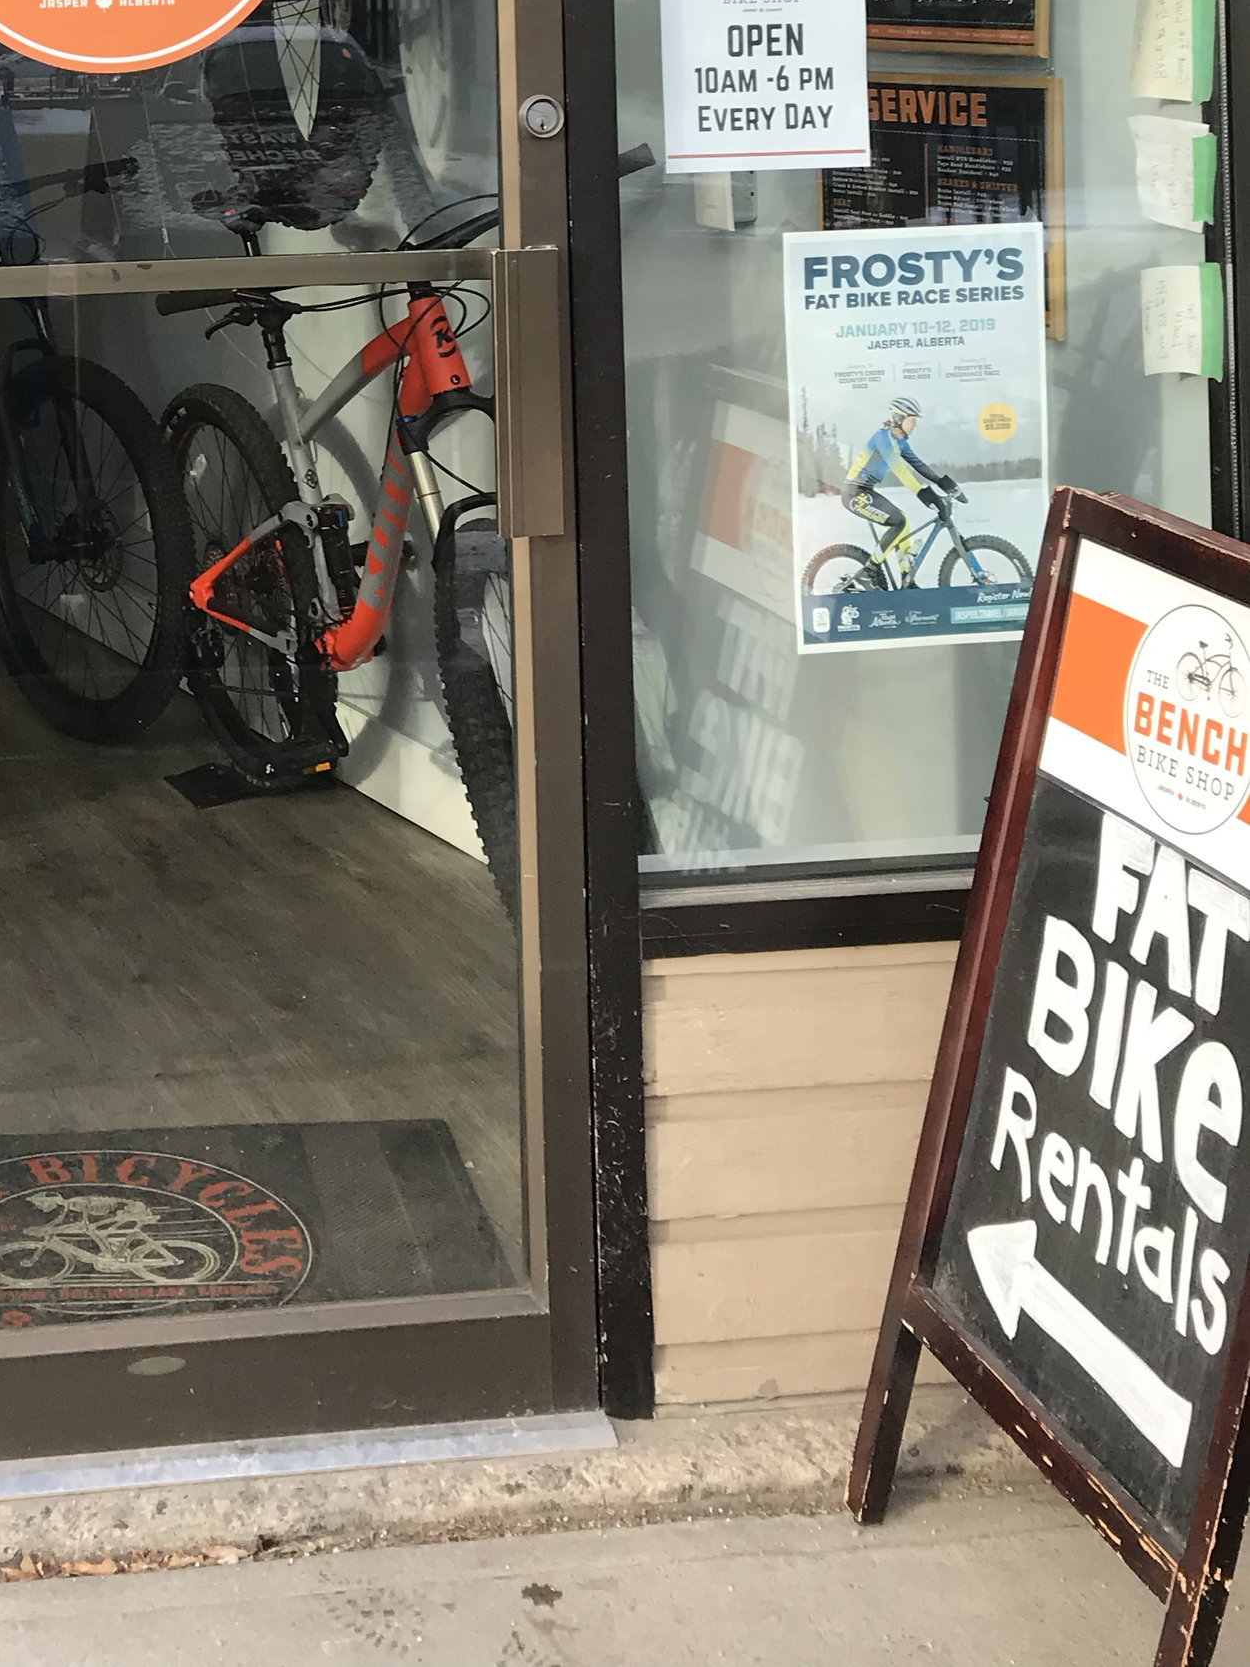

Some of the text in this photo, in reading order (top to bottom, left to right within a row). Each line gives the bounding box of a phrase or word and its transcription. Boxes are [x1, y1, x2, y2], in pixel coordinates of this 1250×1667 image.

[727, 23, 804, 57] OPEN
[694, 67, 757, 94] 10AM
[799, 67, 834, 91] PM
[869, 88, 987, 127] SERVICE
[804, 247, 1024, 290] FROSTY'S
[805, 285, 1024, 310] FAT BIKE RACE SERIES
[835, 317, 996, 338] JANUARY 10-12, 2019
[867, 336, 965, 350] JASPER, ALBERTA
[1147, 670, 1170, 690] THE
[1134, 691, 1250, 777] BENCH
[1136, 745, 1235, 801] BIKE SHOP
[1092, 811, 1250, 1015] FAT
[25, 1155, 303, 1279] BICYCLES
[990, 1065, 1231, 1356] Rentals
